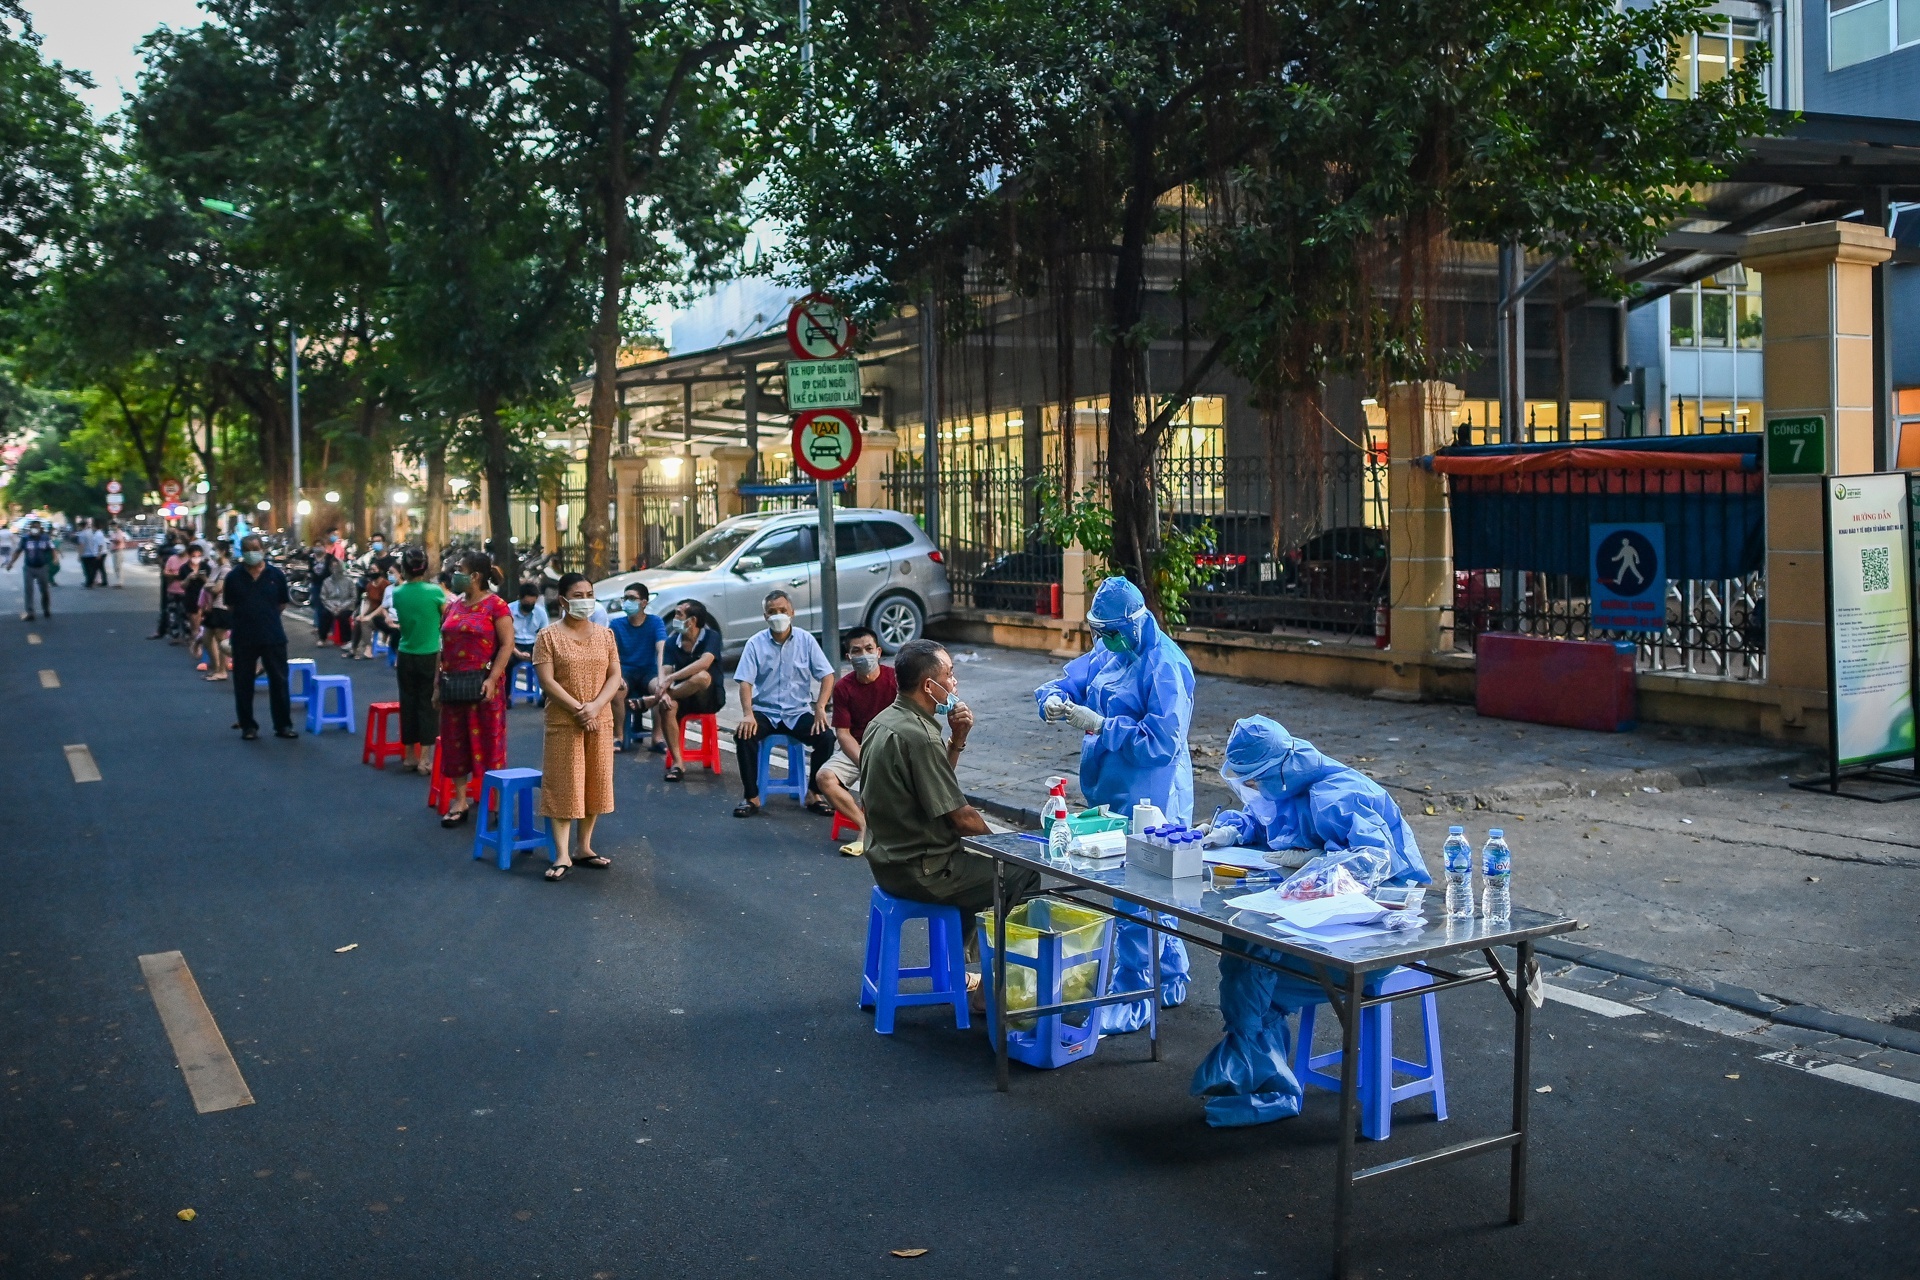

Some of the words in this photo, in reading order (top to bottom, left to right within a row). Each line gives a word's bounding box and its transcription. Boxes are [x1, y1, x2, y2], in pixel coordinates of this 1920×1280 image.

[790, 367, 799, 376] XE
[801, 365, 816, 376] HỢP
[802, 380, 811, 390] 09
[812, 421, 840, 435] TAXI
[1803, 420, 1817, 434] SỐ
[1789, 439, 1806, 464] 7
[1853, 512, 1876, 522] HƯỚNG
